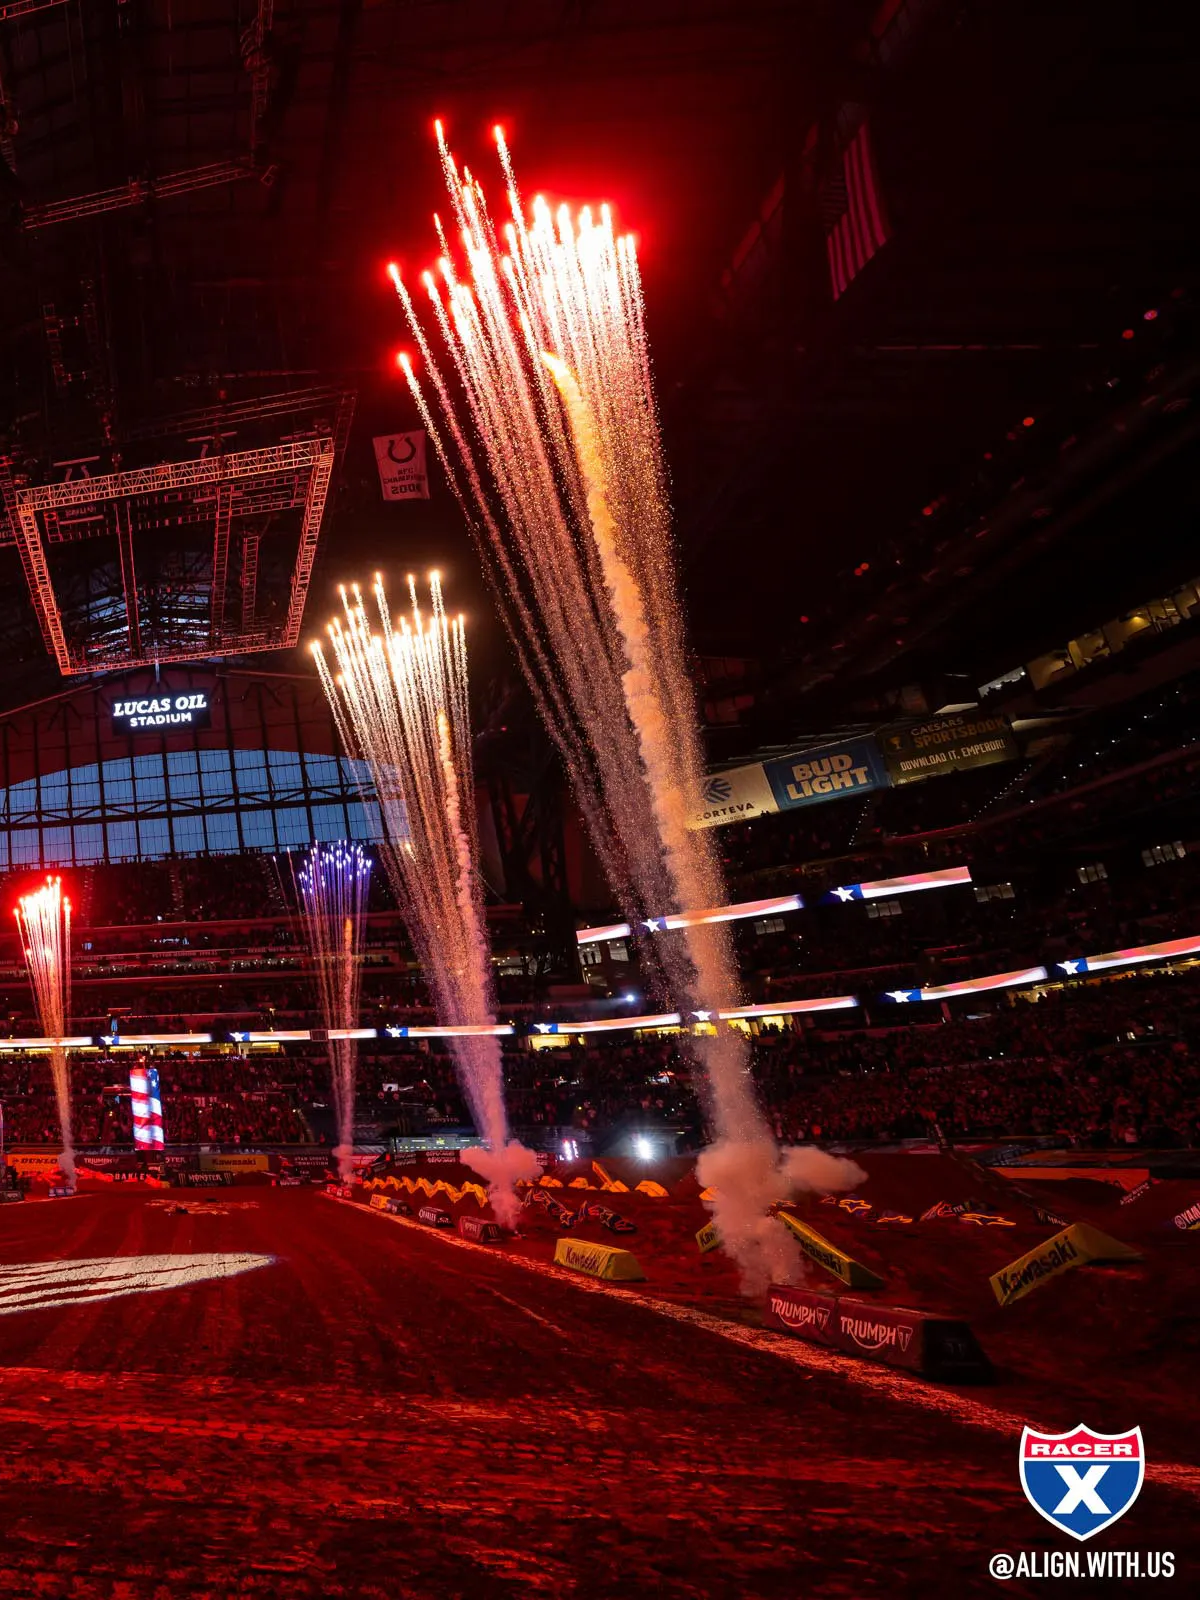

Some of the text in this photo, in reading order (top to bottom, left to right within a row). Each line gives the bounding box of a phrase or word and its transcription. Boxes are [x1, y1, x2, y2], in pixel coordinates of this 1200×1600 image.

[397, 467, 414, 476] AFC
[113, 693, 207, 717] LUCAS OIL
[130, 712, 192, 727] STADIUM
[910, 716, 965, 736] CAESARS
[914, 716, 1006, 748] SPORTSBOOK
[791, 753, 853, 783] BUD
[900, 752, 947, 772] DOWNLOAD
[962, 739, 1006, 758] EMPEROR!
[786, 765, 869, 801] LIGHT
[83, 1156, 114, 1166] TRIUMPH
[211, 1157, 257, 1167] Kawasaki
[188, 1173, 222, 1182] MONSTER
[997, 1235, 1078, 1295] Kawasaki
[770, 1297, 816, 1327] TRIUMPH
[840, 1316, 897, 1350] TRIUMPH
